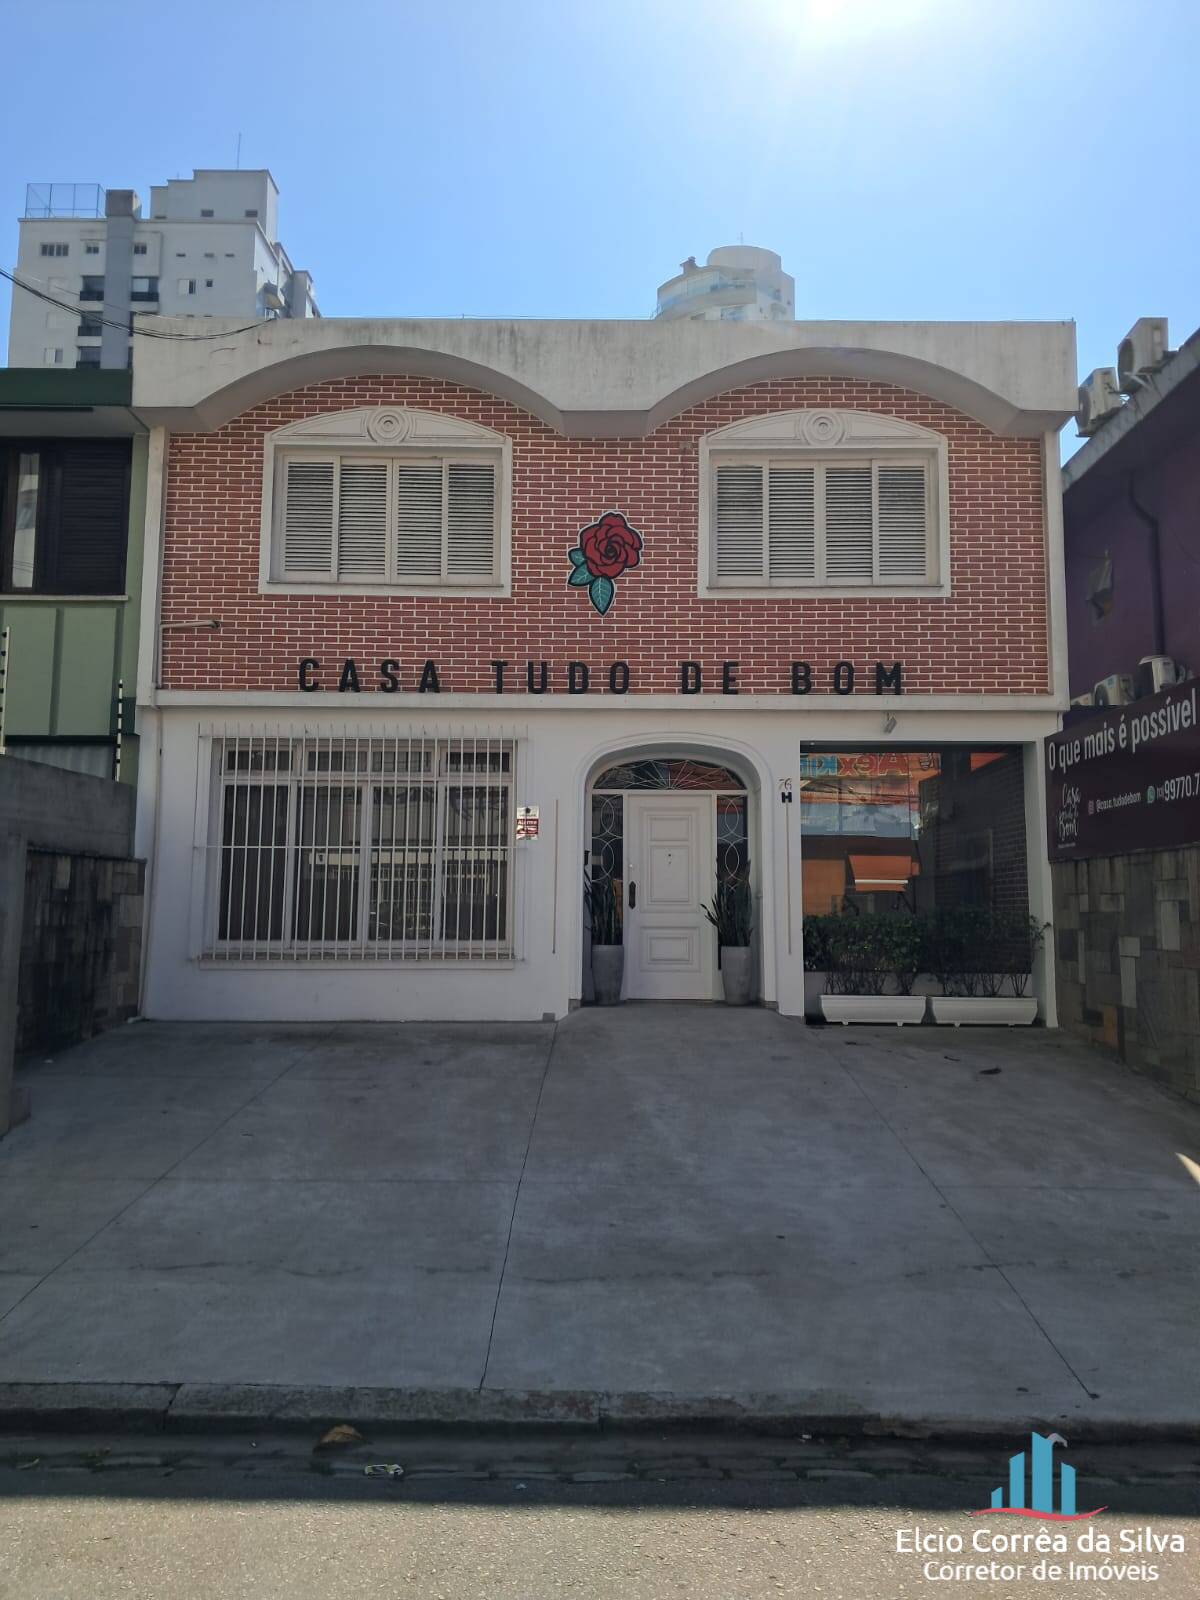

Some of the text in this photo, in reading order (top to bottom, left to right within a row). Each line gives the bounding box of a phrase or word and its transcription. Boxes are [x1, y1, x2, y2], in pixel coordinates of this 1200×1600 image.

[298, 658, 902, 695] CASA TUDO DE BOM
[1048, 687, 1197, 774] O que mais é possível
